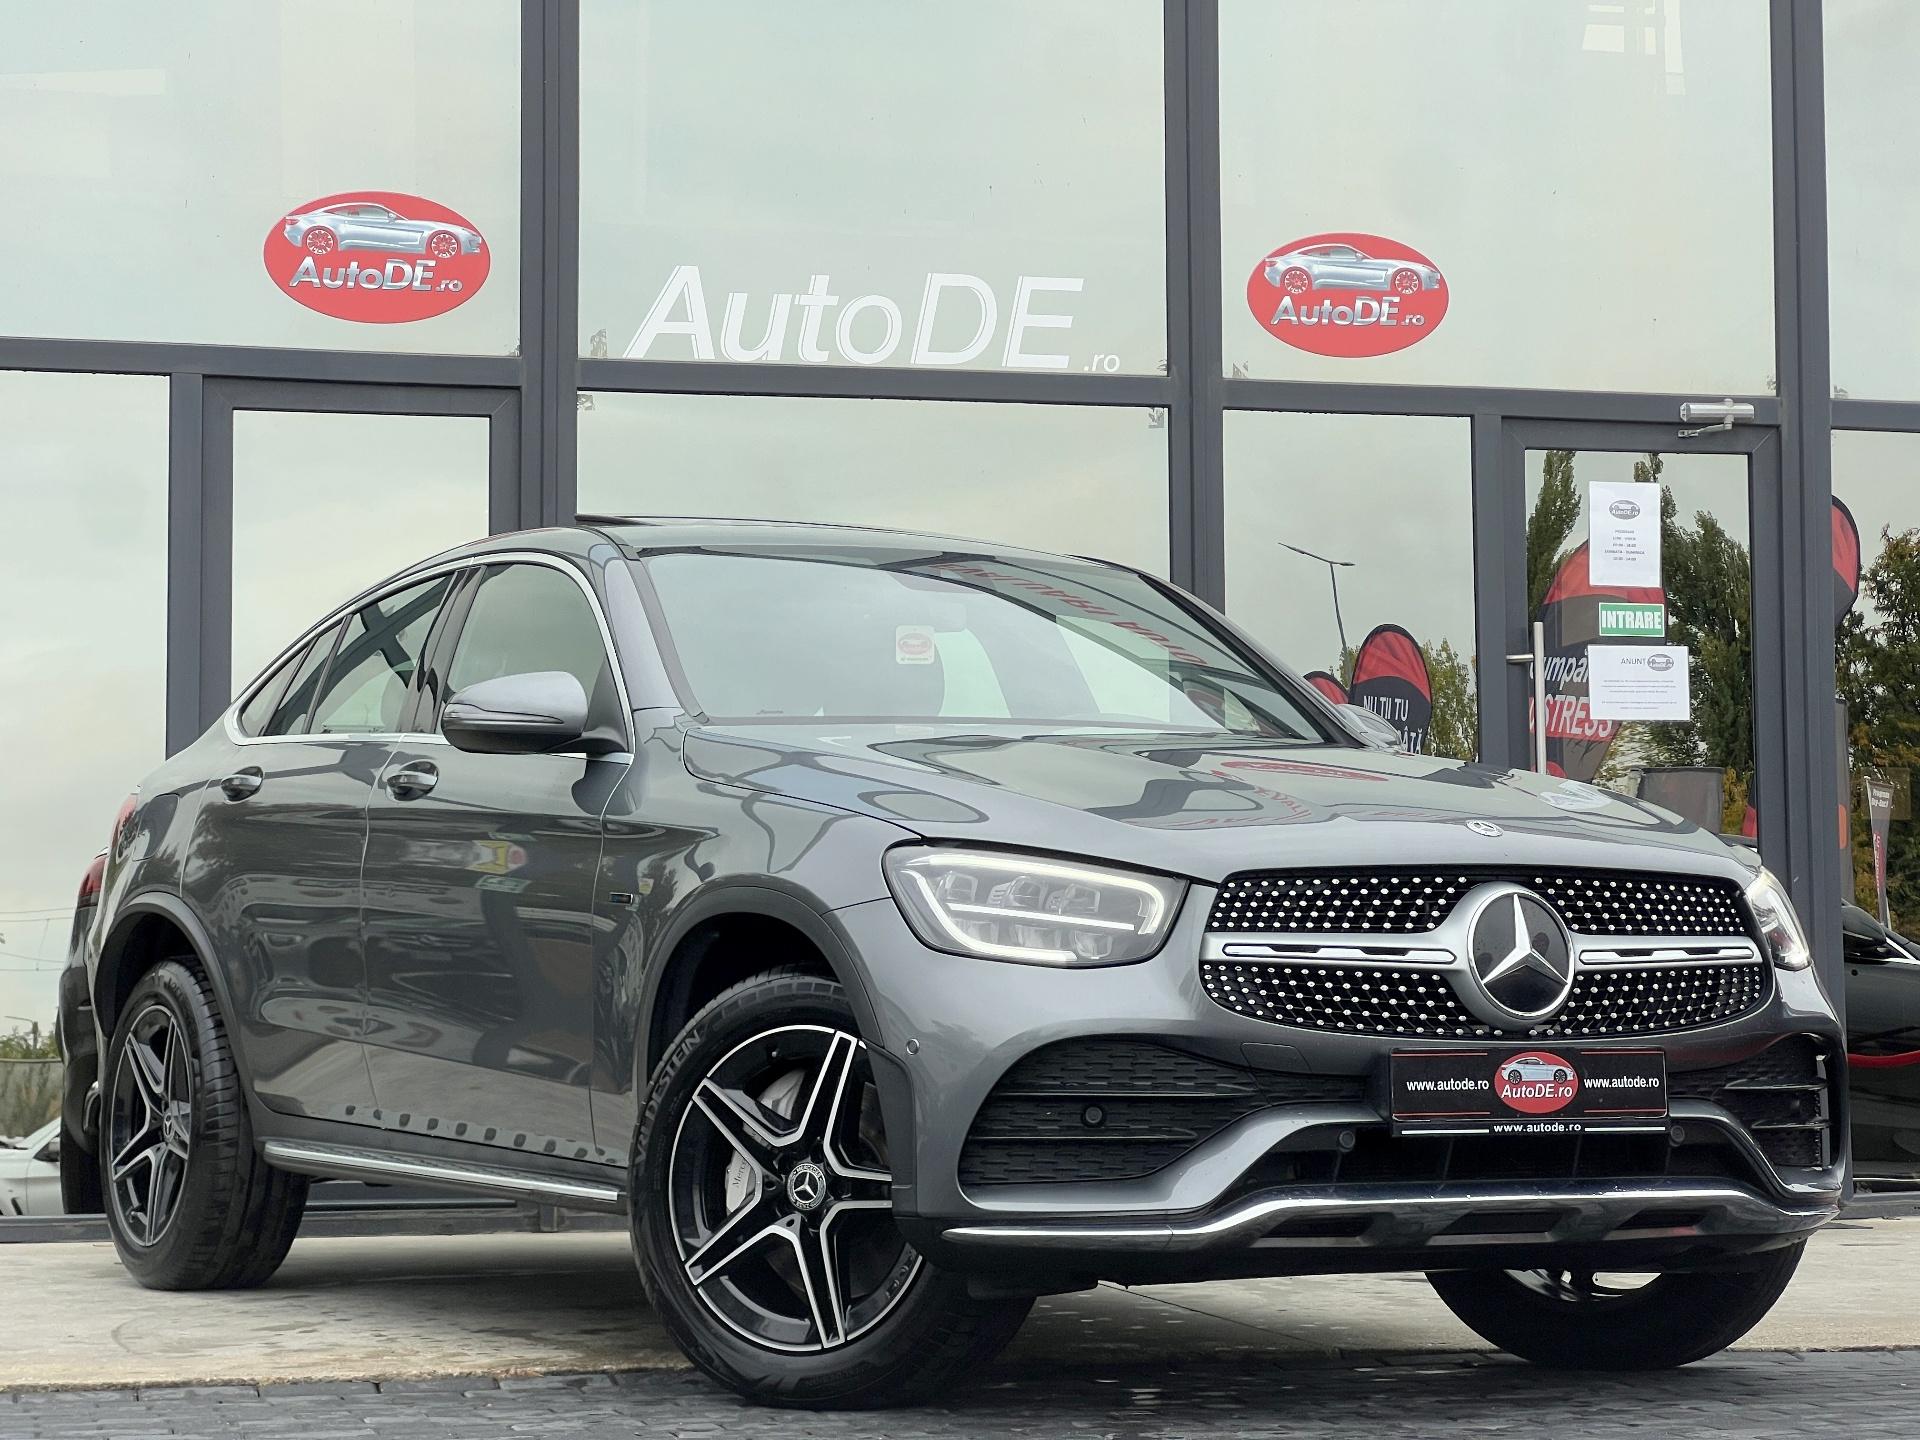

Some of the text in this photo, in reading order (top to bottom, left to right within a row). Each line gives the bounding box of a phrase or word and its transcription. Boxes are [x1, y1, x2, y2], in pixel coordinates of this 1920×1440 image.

[289, 256, 463, 292] AutoDE.ro
[1270, 295, 1425, 326] AutoDE.ro
[1601, 611, 1662, 629] INTRARE
[1395, 698, 1409, 722] TU
[1406, 1075, 1660, 1099] www.autode.ro AutoDE.ro www.autode.ro
[1493, 1121, 1582, 1133] www.autode.ro
